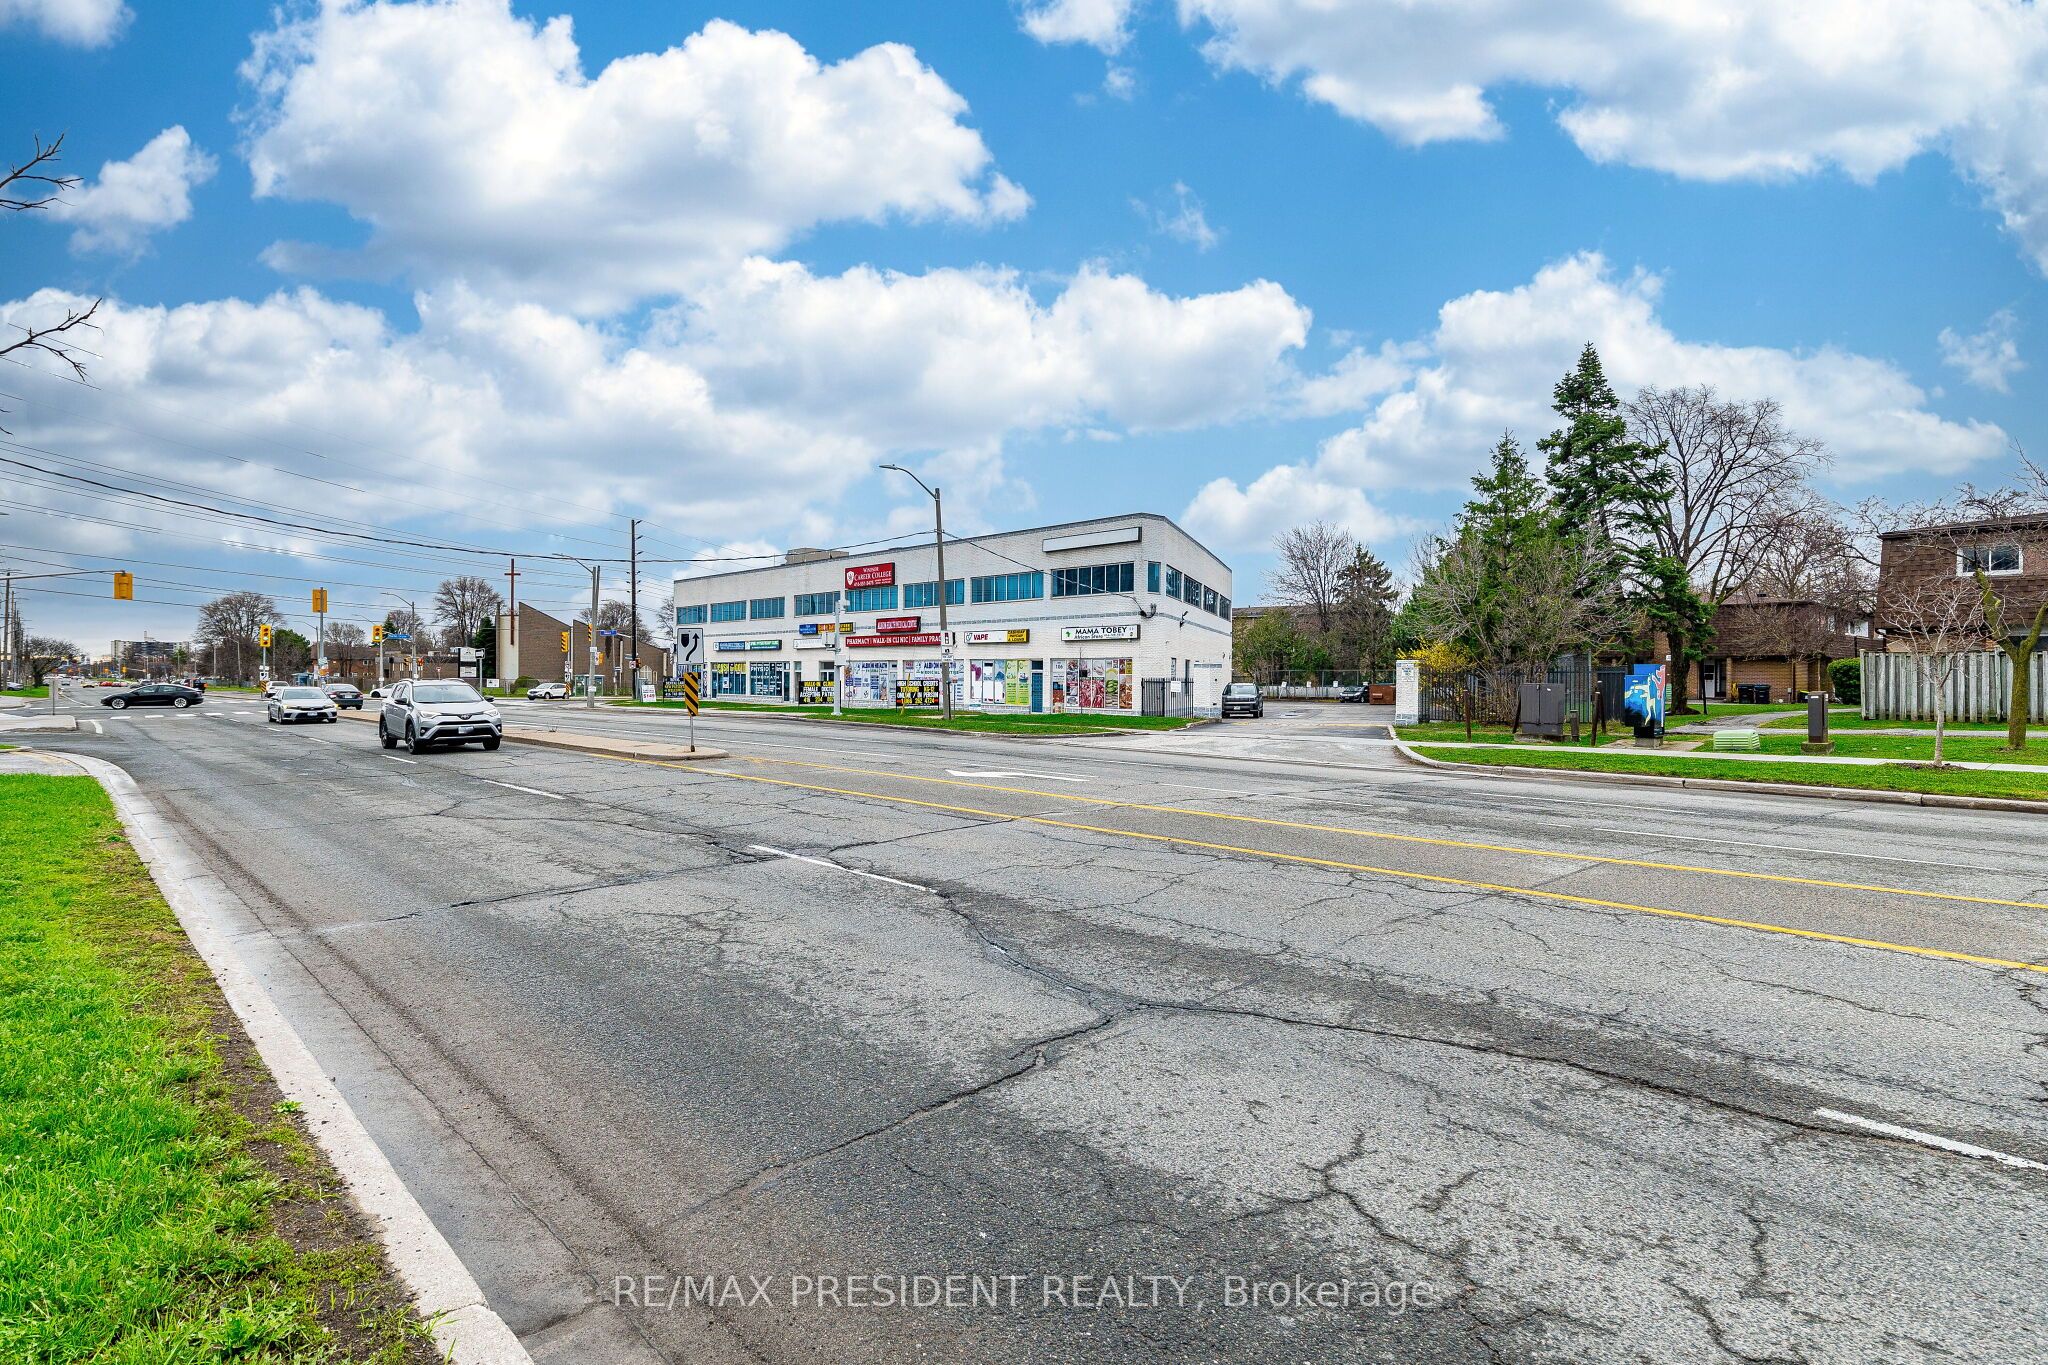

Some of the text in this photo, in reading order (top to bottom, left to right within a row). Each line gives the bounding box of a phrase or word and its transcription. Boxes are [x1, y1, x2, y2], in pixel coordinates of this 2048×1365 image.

[854, 571, 892, 581] CAREER COLLEGE
[1101, 626, 1128, 634] TOBEY
[847, 637, 870, 645] PHARMACY
[892, 636, 909, 644] CLINIC
[911, 635, 928, 643] FAMILY
[973, 633, 989, 641] VAPE
